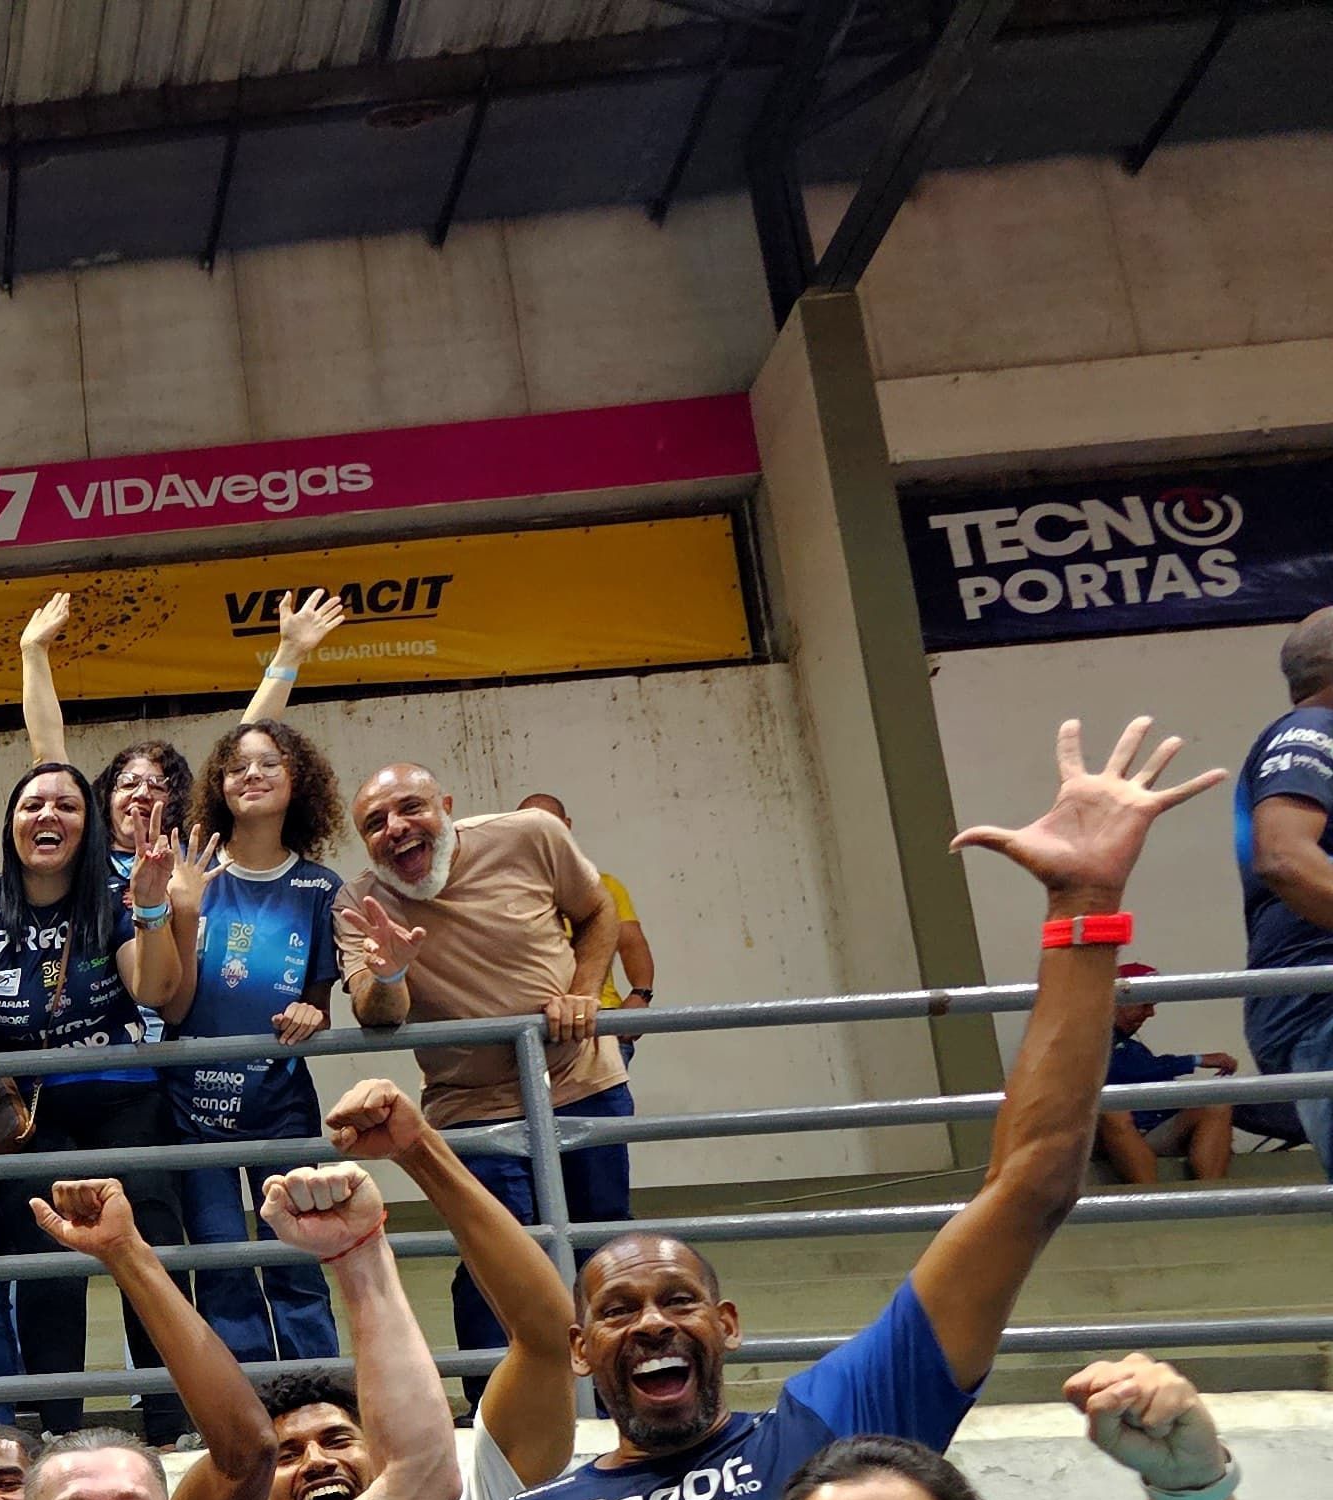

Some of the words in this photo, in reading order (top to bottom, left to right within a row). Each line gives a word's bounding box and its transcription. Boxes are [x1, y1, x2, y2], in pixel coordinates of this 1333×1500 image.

[56, 462, 375, 514] VIDAvegas
[959, 549, 1242, 621] PORTAS
[318, 640, 437, 663] GUARULHOS
[195, 1070, 245, 1085] SUZANO
[192, 1096, 242, 1113] sanofi
